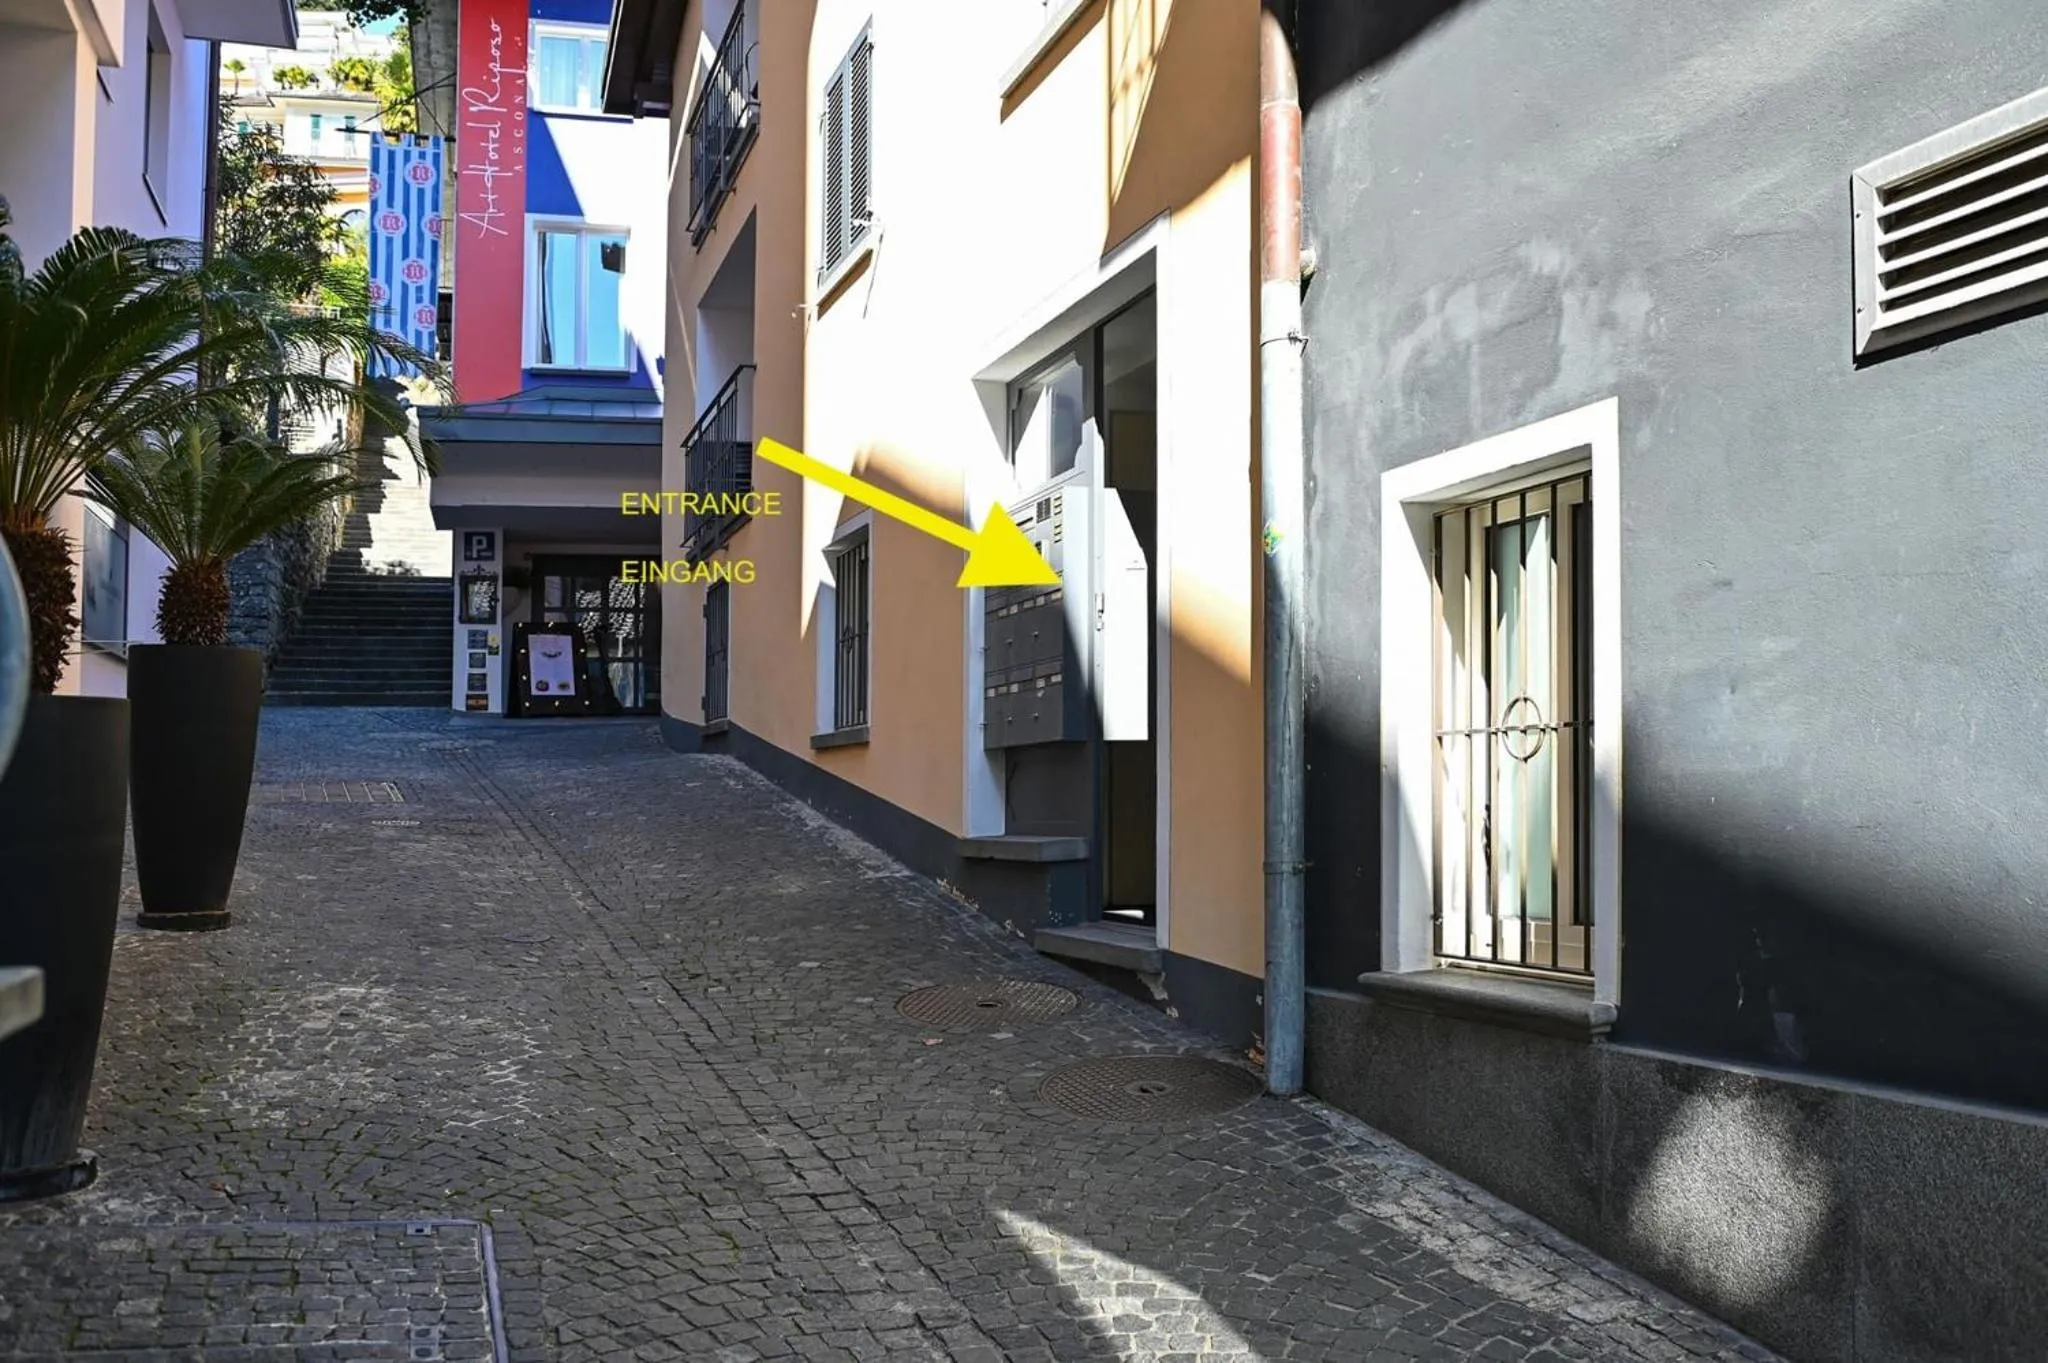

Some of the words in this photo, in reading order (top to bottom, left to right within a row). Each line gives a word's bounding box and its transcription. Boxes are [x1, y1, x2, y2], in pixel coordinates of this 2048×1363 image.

[462, 17, 527, 112] Riposo
[513, 78, 524, 173] ASCONA
[472, 536, 487, 558] P
